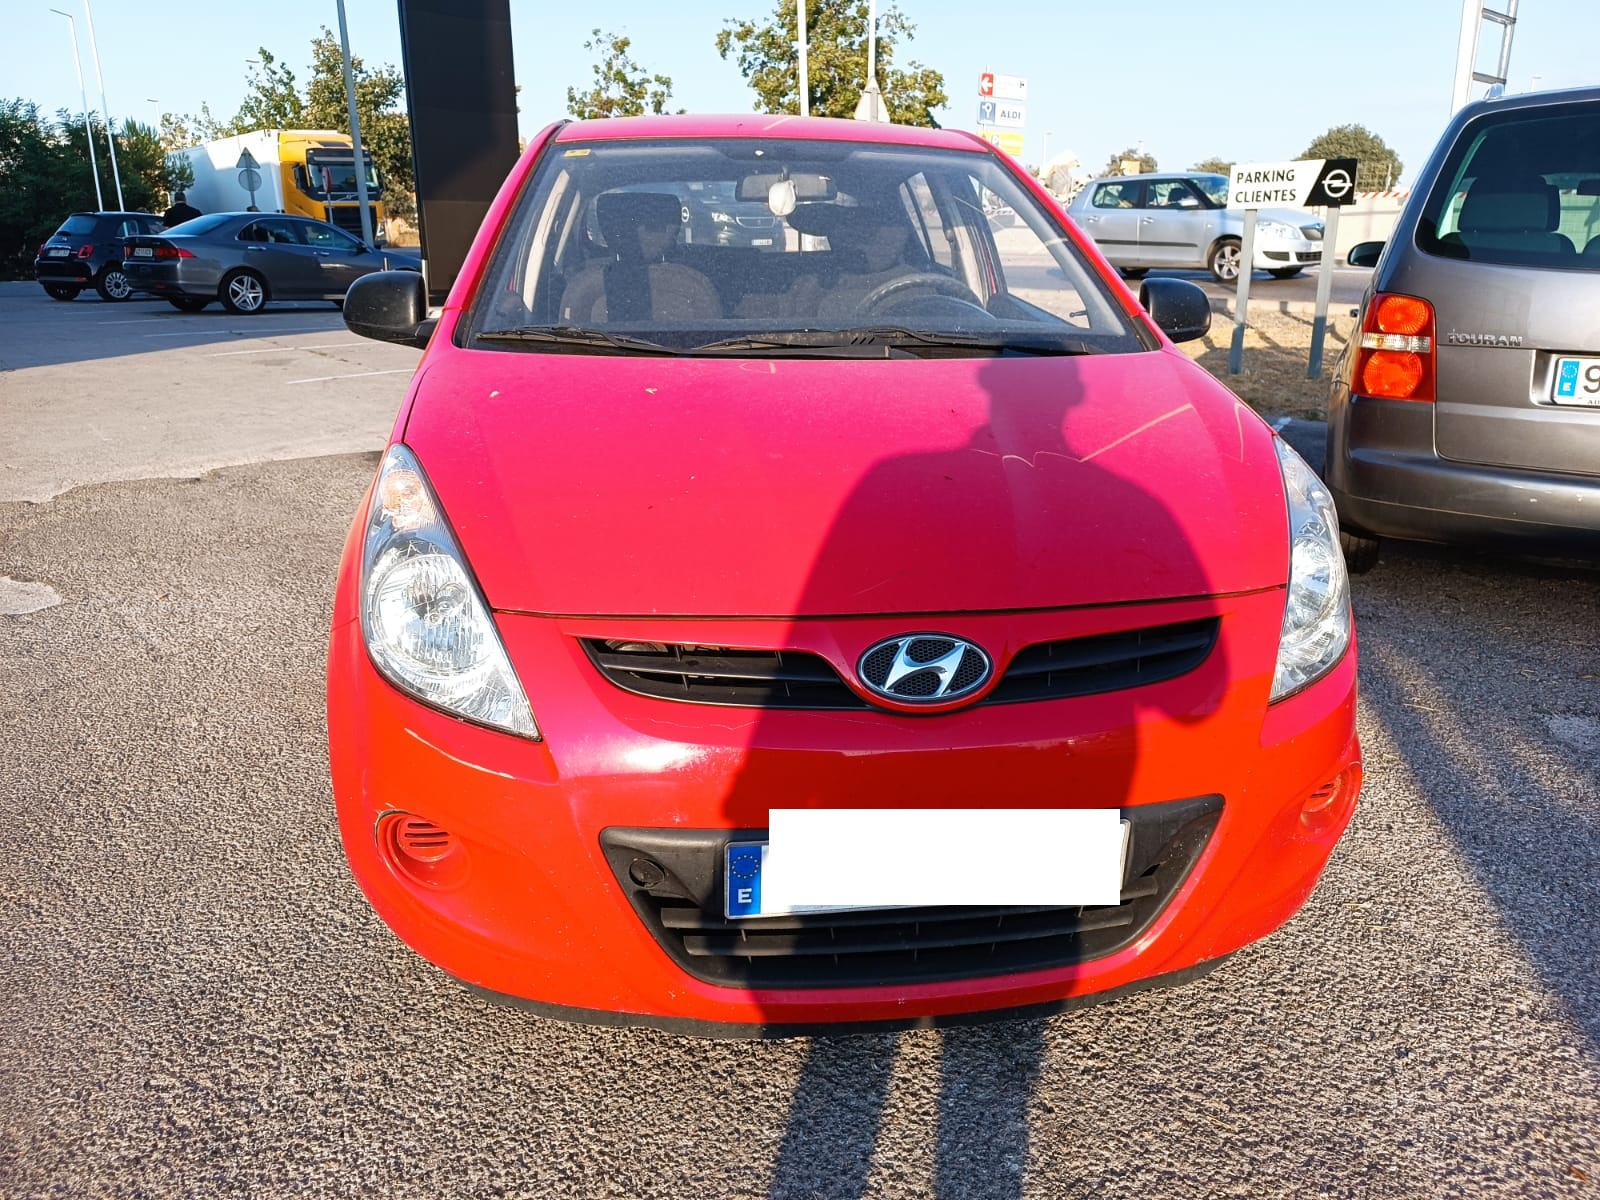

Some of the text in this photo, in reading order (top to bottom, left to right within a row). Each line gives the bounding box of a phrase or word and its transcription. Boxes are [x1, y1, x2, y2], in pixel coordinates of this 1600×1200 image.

[1000, 110, 1021, 120] ALDI
[1236, 169, 1295, 184] PARKING
[1235, 189, 1297, 203] CLIENTES
[1448, 329, 1523, 347] TOURAN
[1562, 382, 1572, 392] E
[738, 888, 752, 904] E
